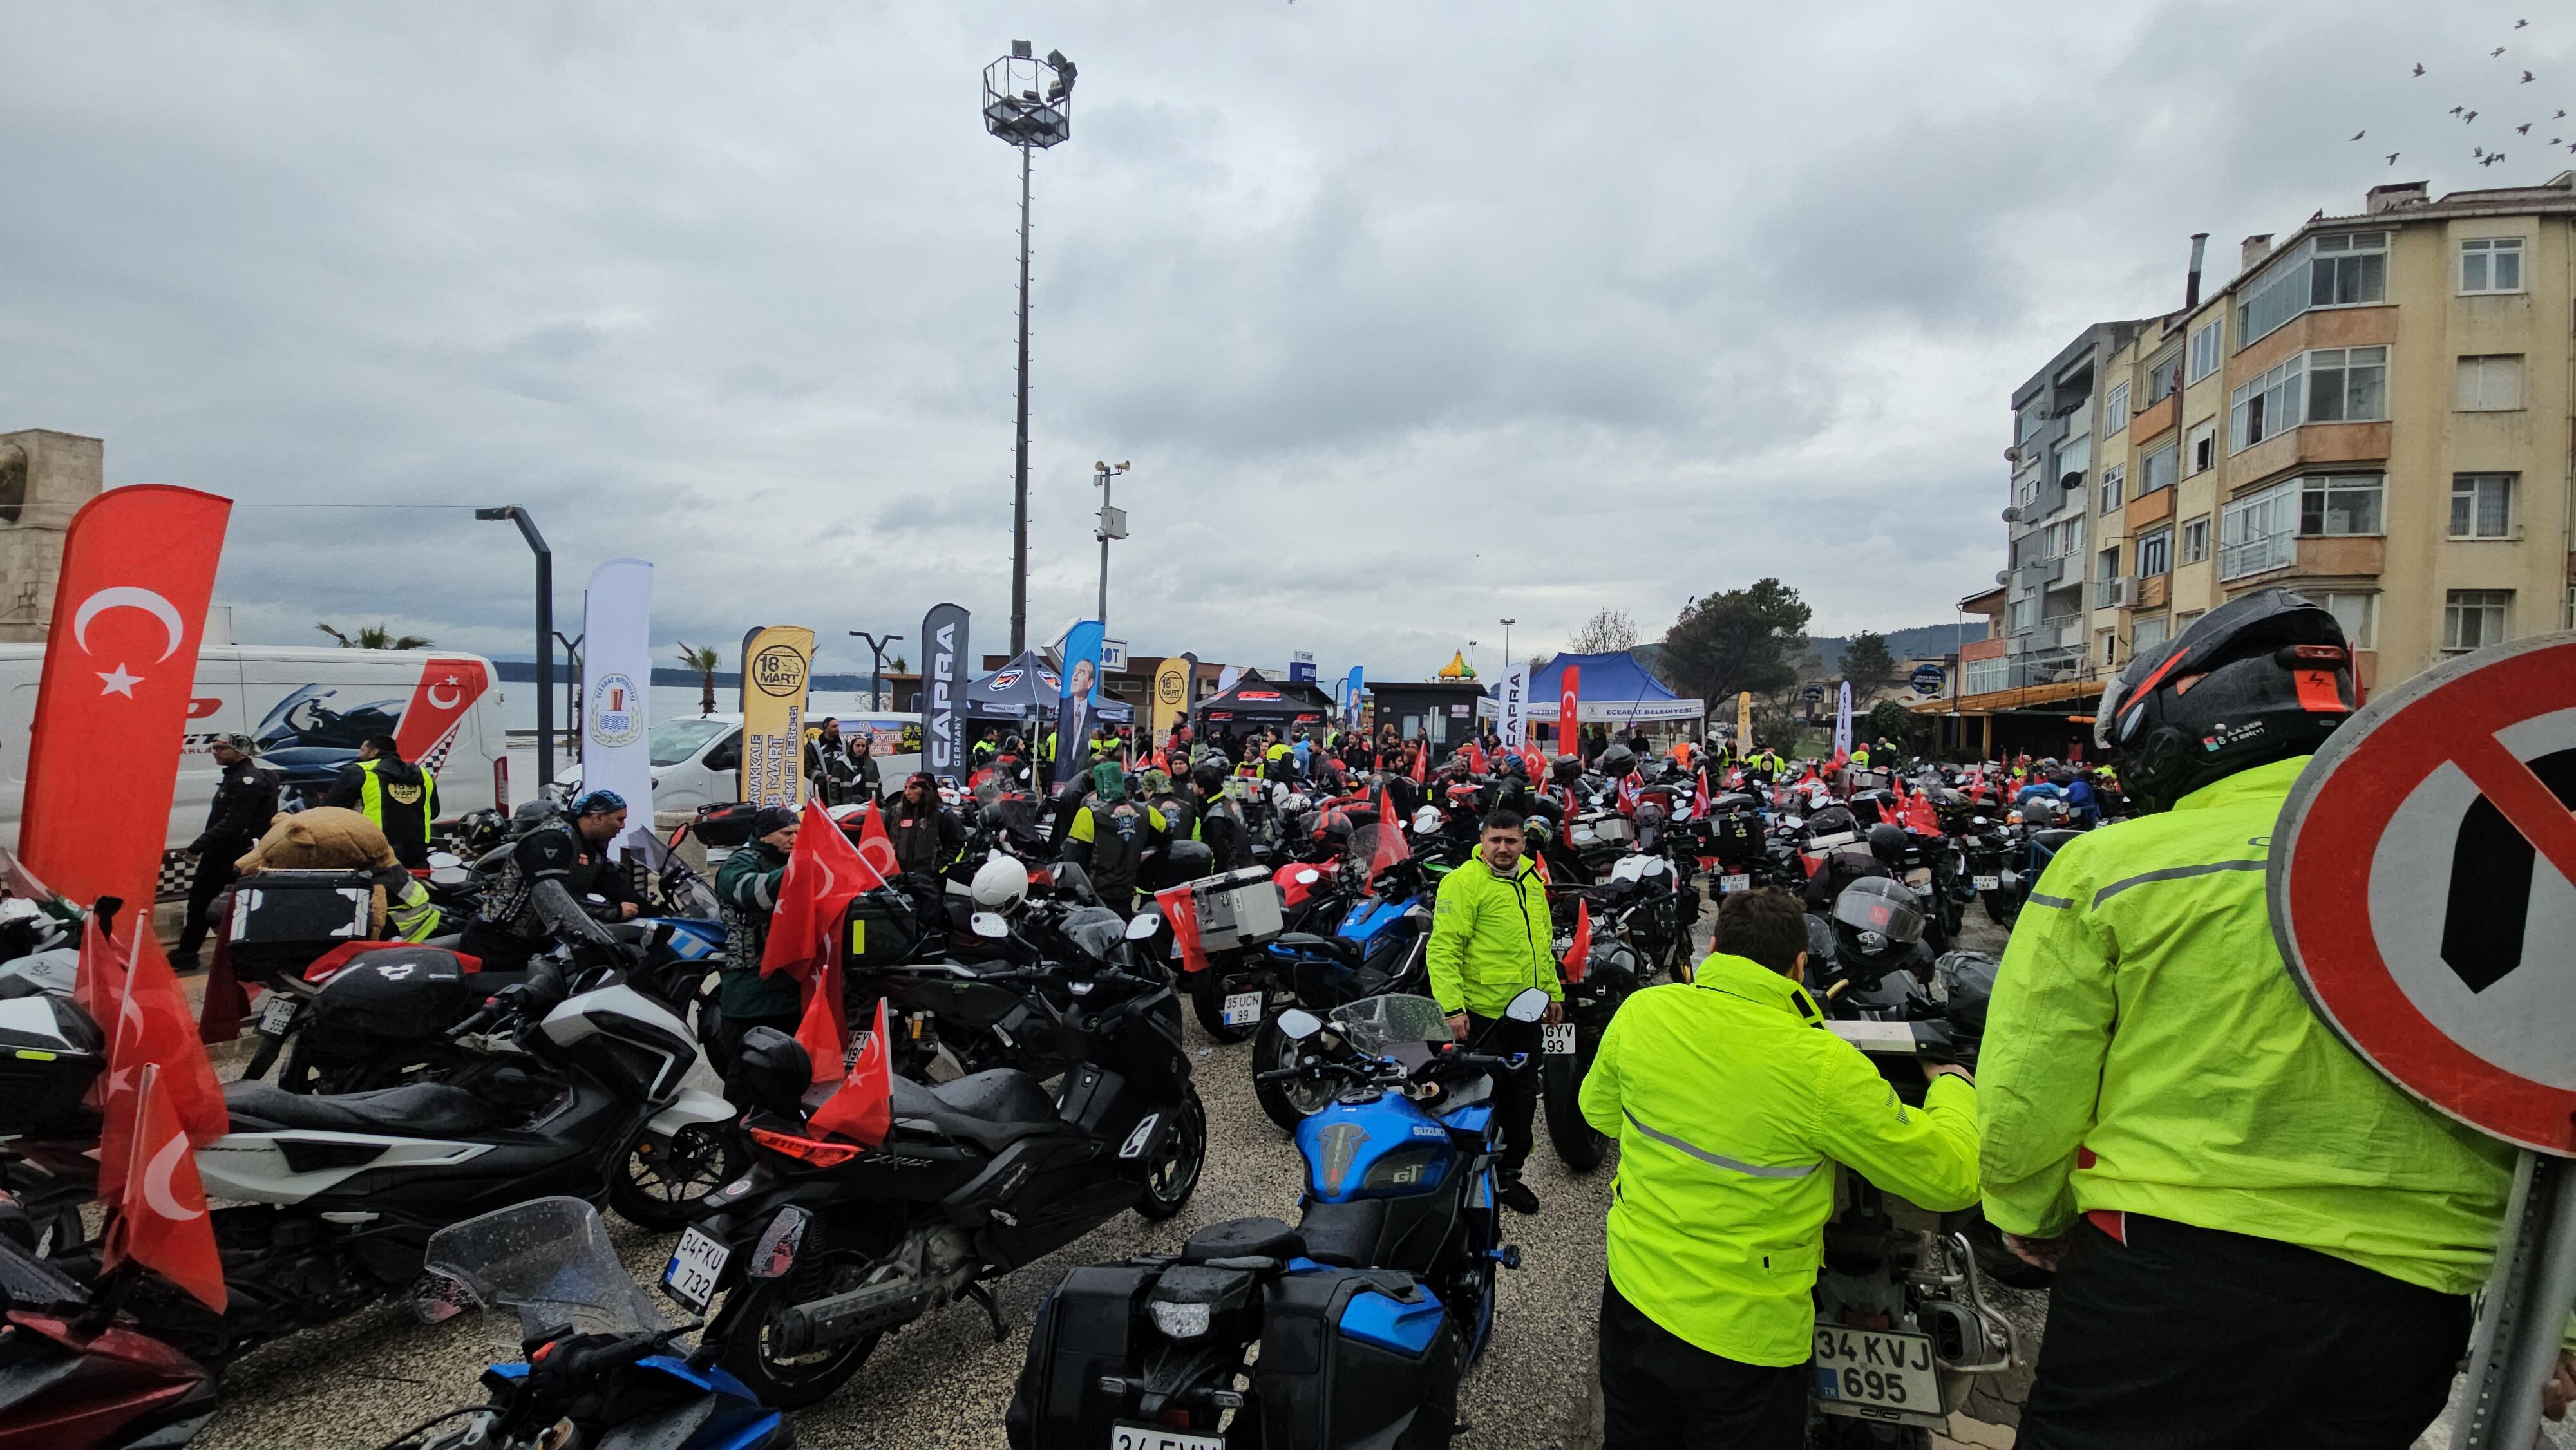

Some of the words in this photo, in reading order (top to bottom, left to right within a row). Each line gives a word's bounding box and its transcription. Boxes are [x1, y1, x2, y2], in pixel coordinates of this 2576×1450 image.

[759, 655, 779, 672] 18
[1100, 647, 1119, 664] OT
[760, 672, 799, 684] MART
[1161, 678, 1171, 689] 18
[932, 623, 955, 767] CAPRA
[1506, 673, 1520, 747] CAPRA
[953, 715, 962, 767] GERMANY
[766, 735, 784, 789] MART
[1227, 997, 1238, 1009] 35
[1239, 994, 1259, 1007] UCN
[1237, 1009, 1249, 1021] 99
[1546, 1024, 1573, 1038] GYV
[1413, 1126, 1446, 1137] SUZUKI
[1393, 1164, 1423, 1183] GT
[682, 1268, 710, 1299] 732
[1817, 1330, 1857, 1362] 34
[1864, 1335, 1930, 1371] KVJ
[1823, 1386, 1836, 1397] TR
[1843, 1368, 1907, 1404] 695
